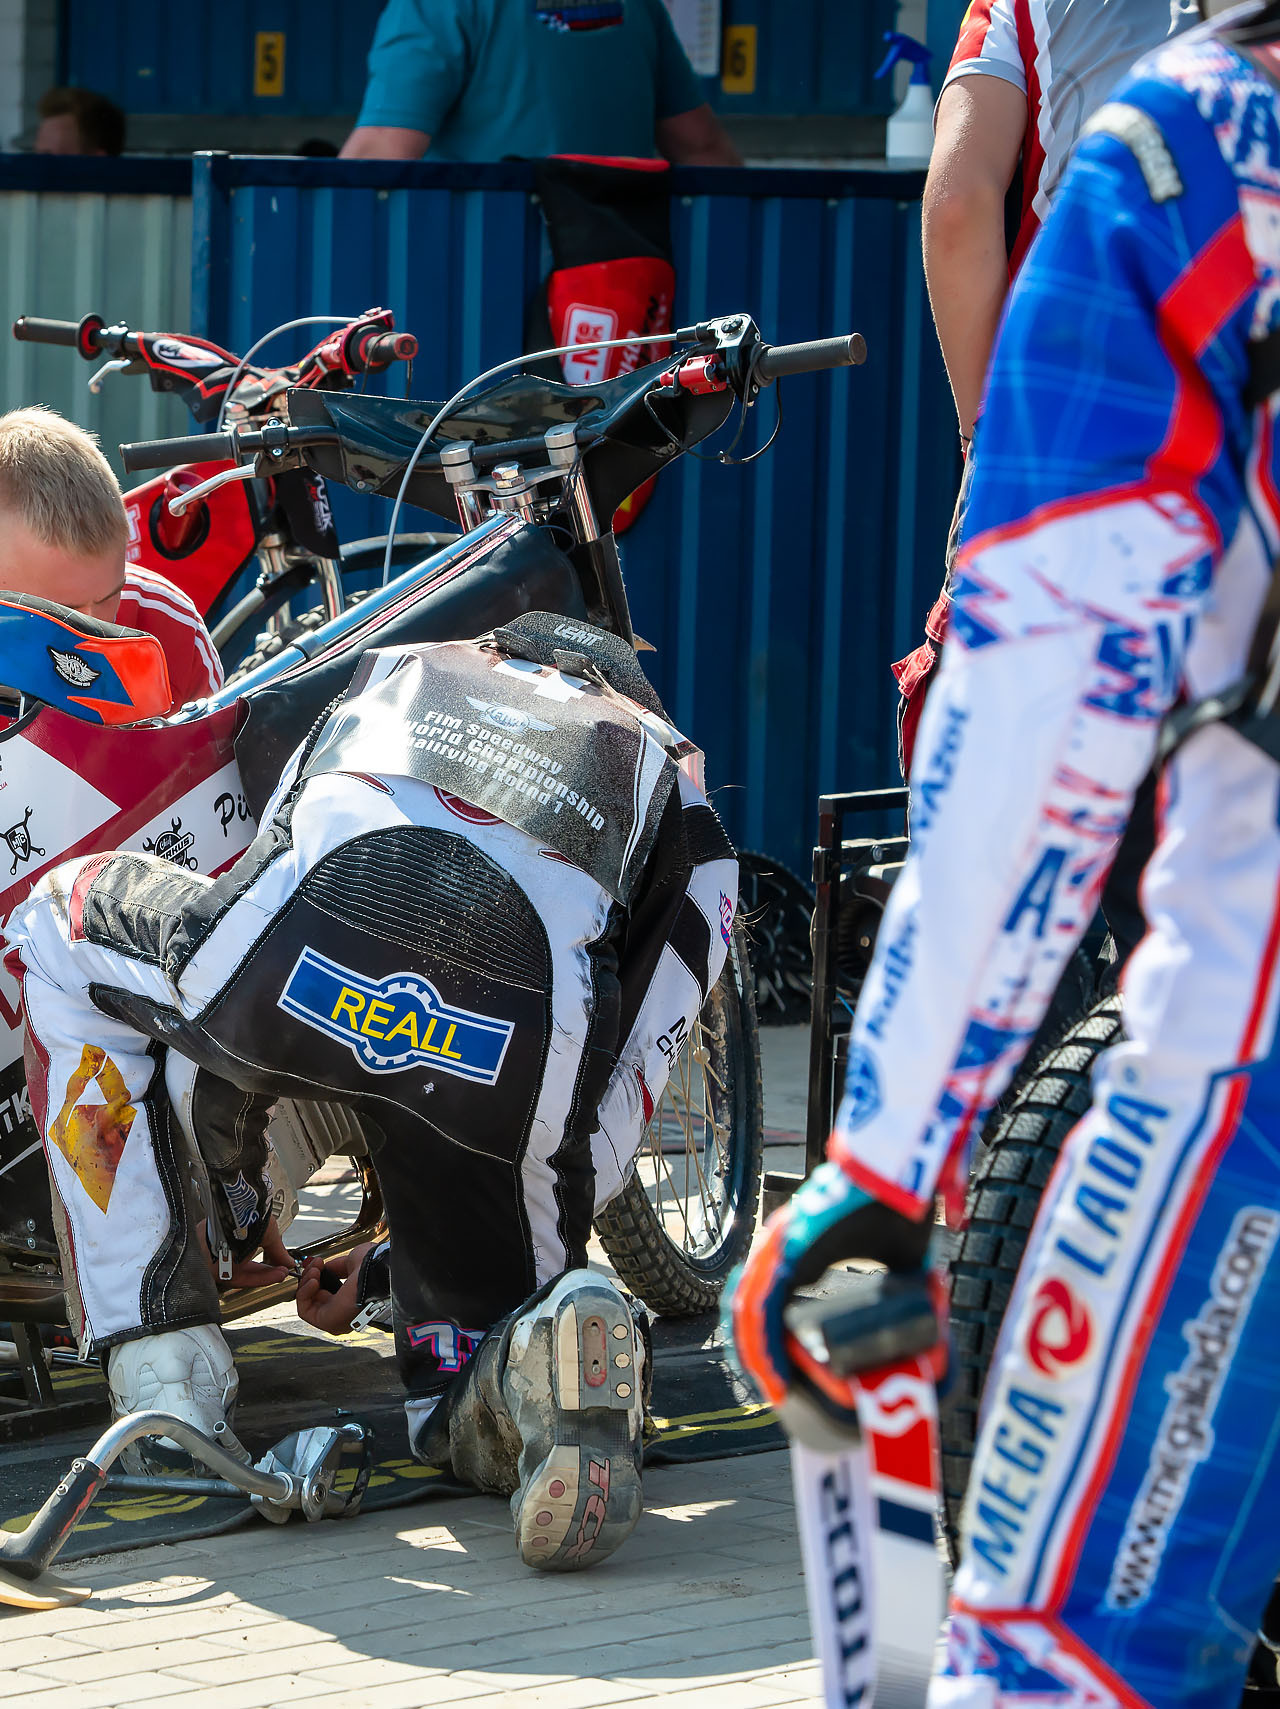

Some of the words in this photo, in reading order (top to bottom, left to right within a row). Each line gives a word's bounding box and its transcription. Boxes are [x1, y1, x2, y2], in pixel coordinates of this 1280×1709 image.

[262, 43, 277, 82] 5
[731, 38, 746, 79] 6
[424, 711, 463, 730] FIM
[466, 723, 563, 775] Speedway
[468, 739, 606, 831] Championship
[492, 768, 552, 806] Round
[553, 801, 563, 814] 1
[330, 986, 462, 1060] REALL
[970, 1388, 1066, 1577] MEGA
[1055, 1093, 1170, 1279] LADA
